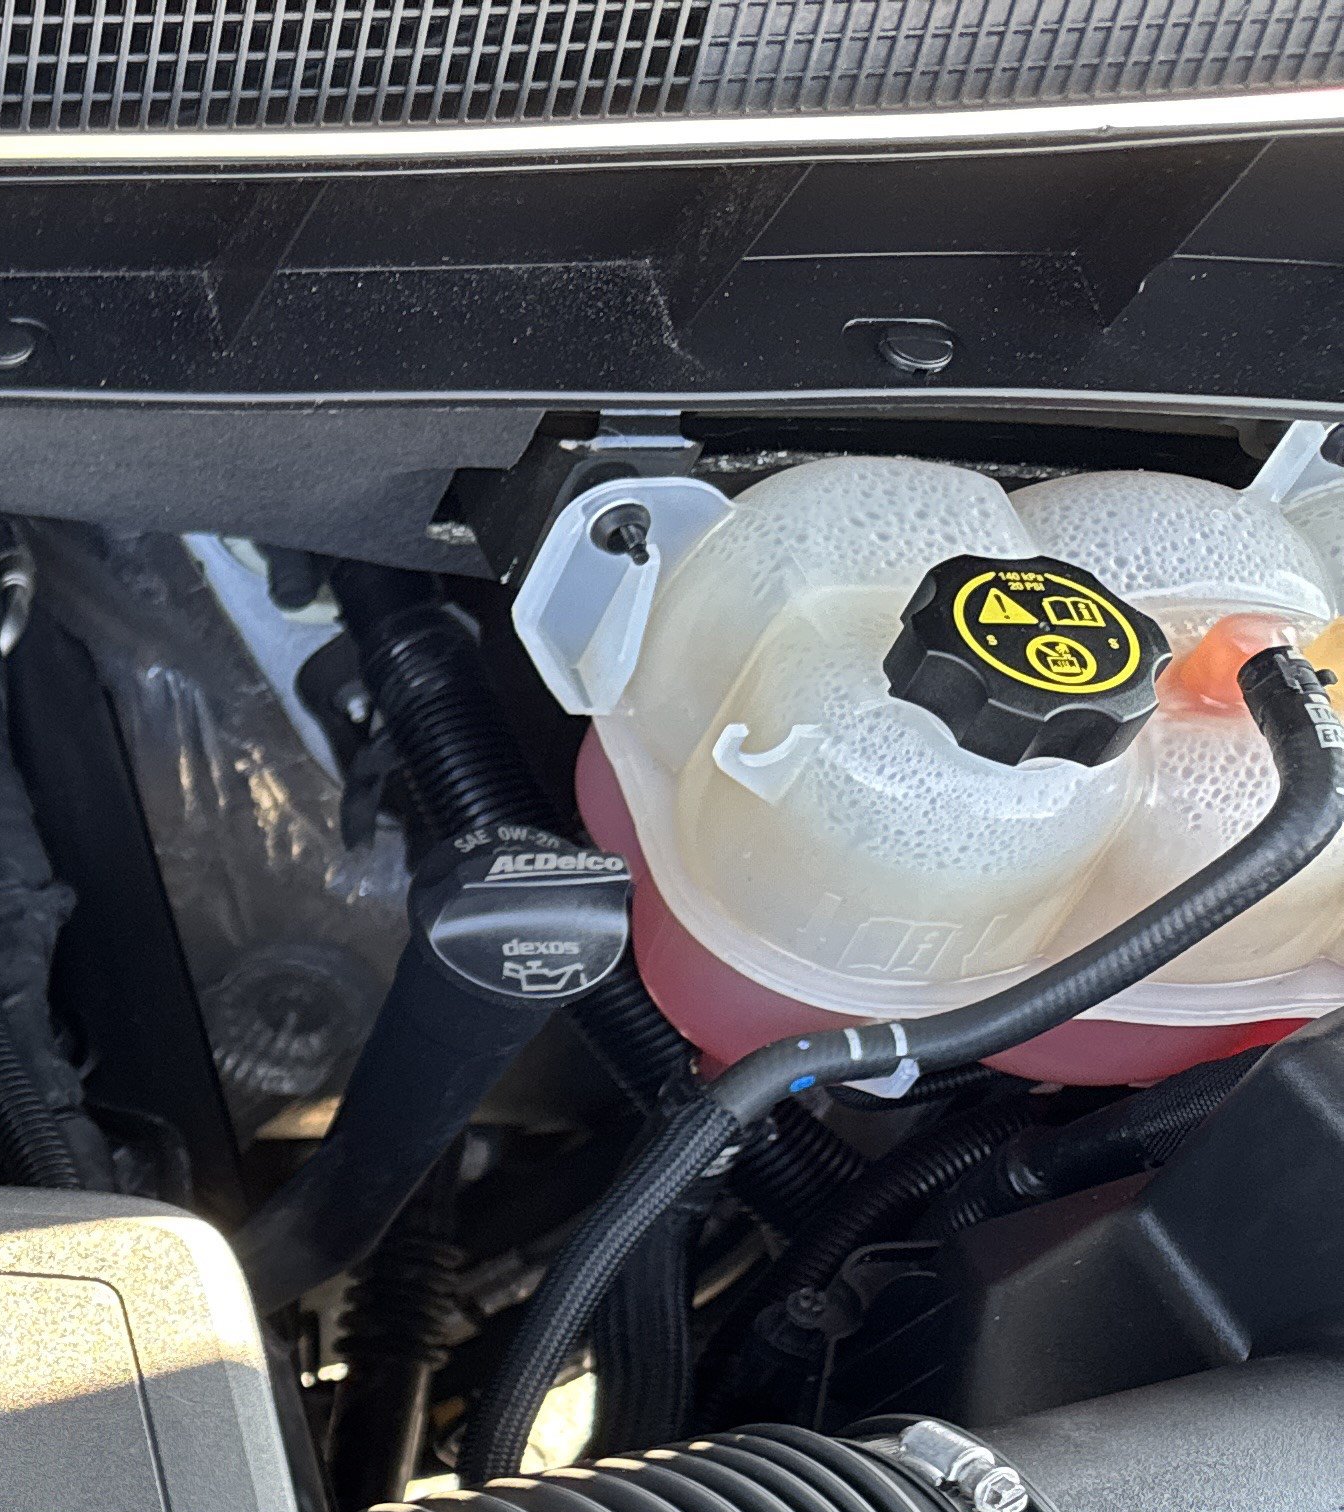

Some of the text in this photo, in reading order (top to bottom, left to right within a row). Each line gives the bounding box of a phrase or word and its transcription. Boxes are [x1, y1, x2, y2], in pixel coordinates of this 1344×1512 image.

[453, 829, 493, 853] SAE
[488, 852, 625, 875] ACDelco
[502, 938, 581, 956] dexos
